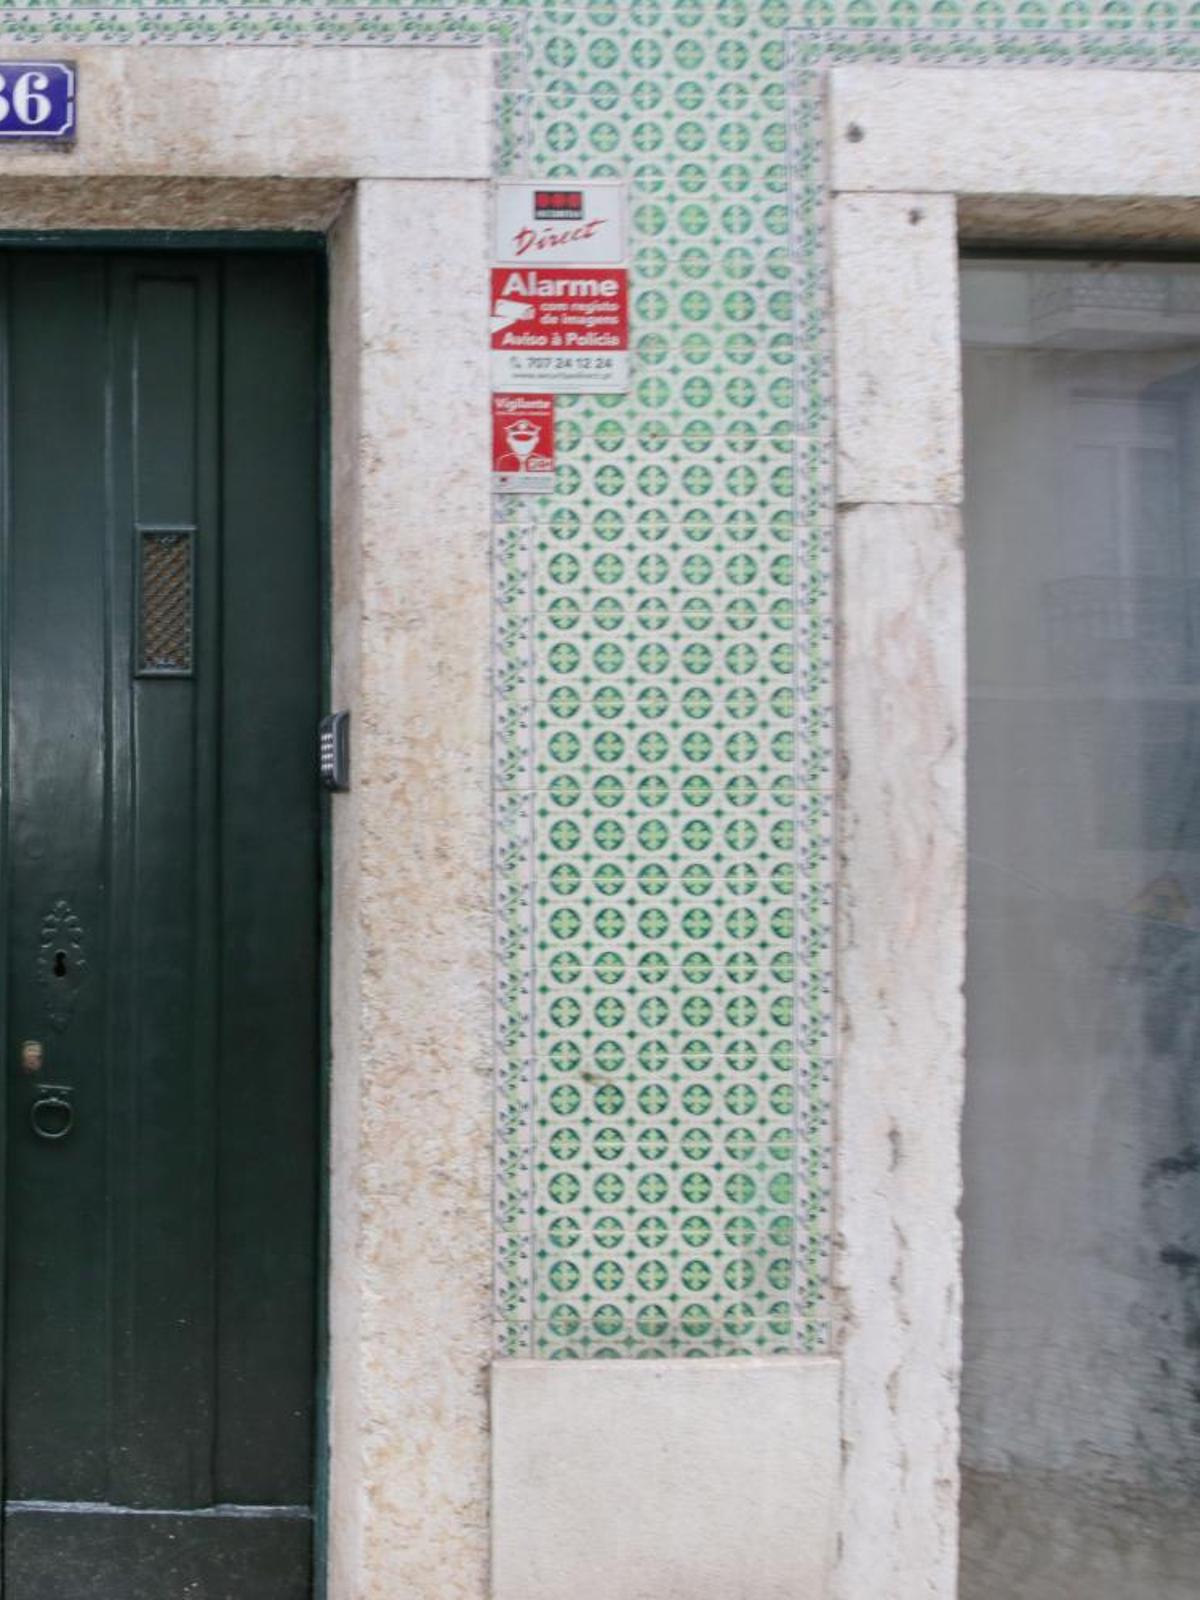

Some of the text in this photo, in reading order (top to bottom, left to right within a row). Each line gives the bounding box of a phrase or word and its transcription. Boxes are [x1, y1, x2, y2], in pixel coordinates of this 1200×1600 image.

[514, 218, 607, 257] Direct
[502, 271, 620, 297] Alarme
[540, 300, 620, 314] com registo
[540, 312, 620, 328] de imagens
[502, 332, 548, 346] Aviso
[528, 356, 612, 369] 707 24 12 24
[494, 397, 551, 412] Vigilante
